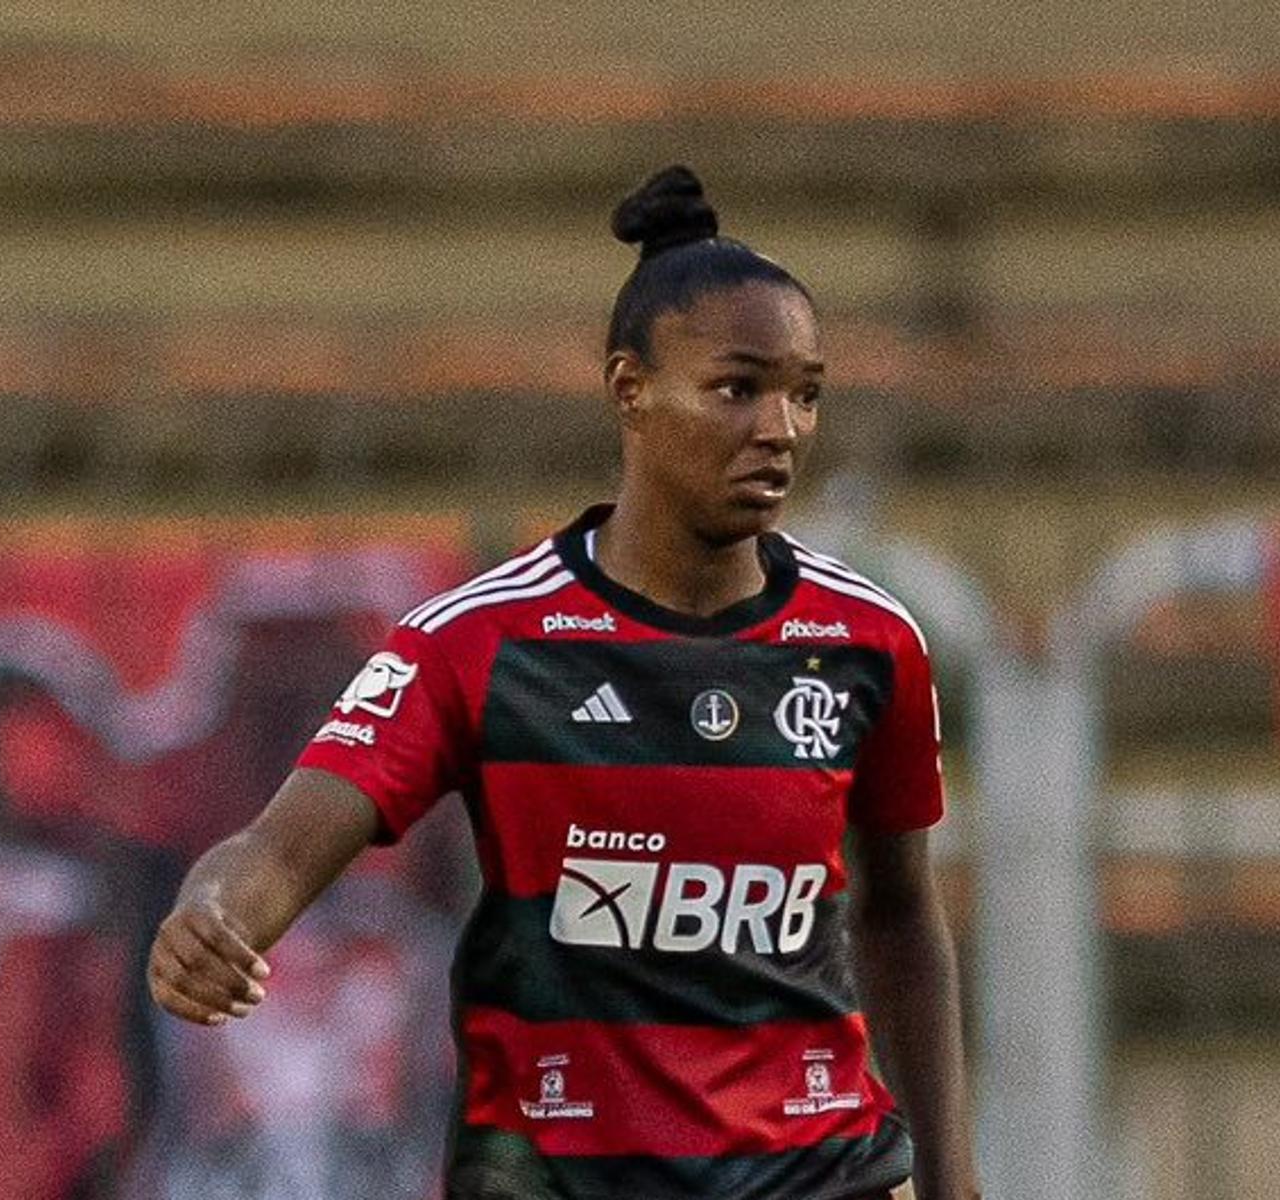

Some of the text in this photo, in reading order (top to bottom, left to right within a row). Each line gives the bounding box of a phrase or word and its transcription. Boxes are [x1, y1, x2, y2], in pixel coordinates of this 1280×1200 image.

[542, 612, 617, 634] pixbet
[780, 618, 851, 642] pixbet
[566, 823, 667, 852] banco
[652, 862, 828, 955] BRB
